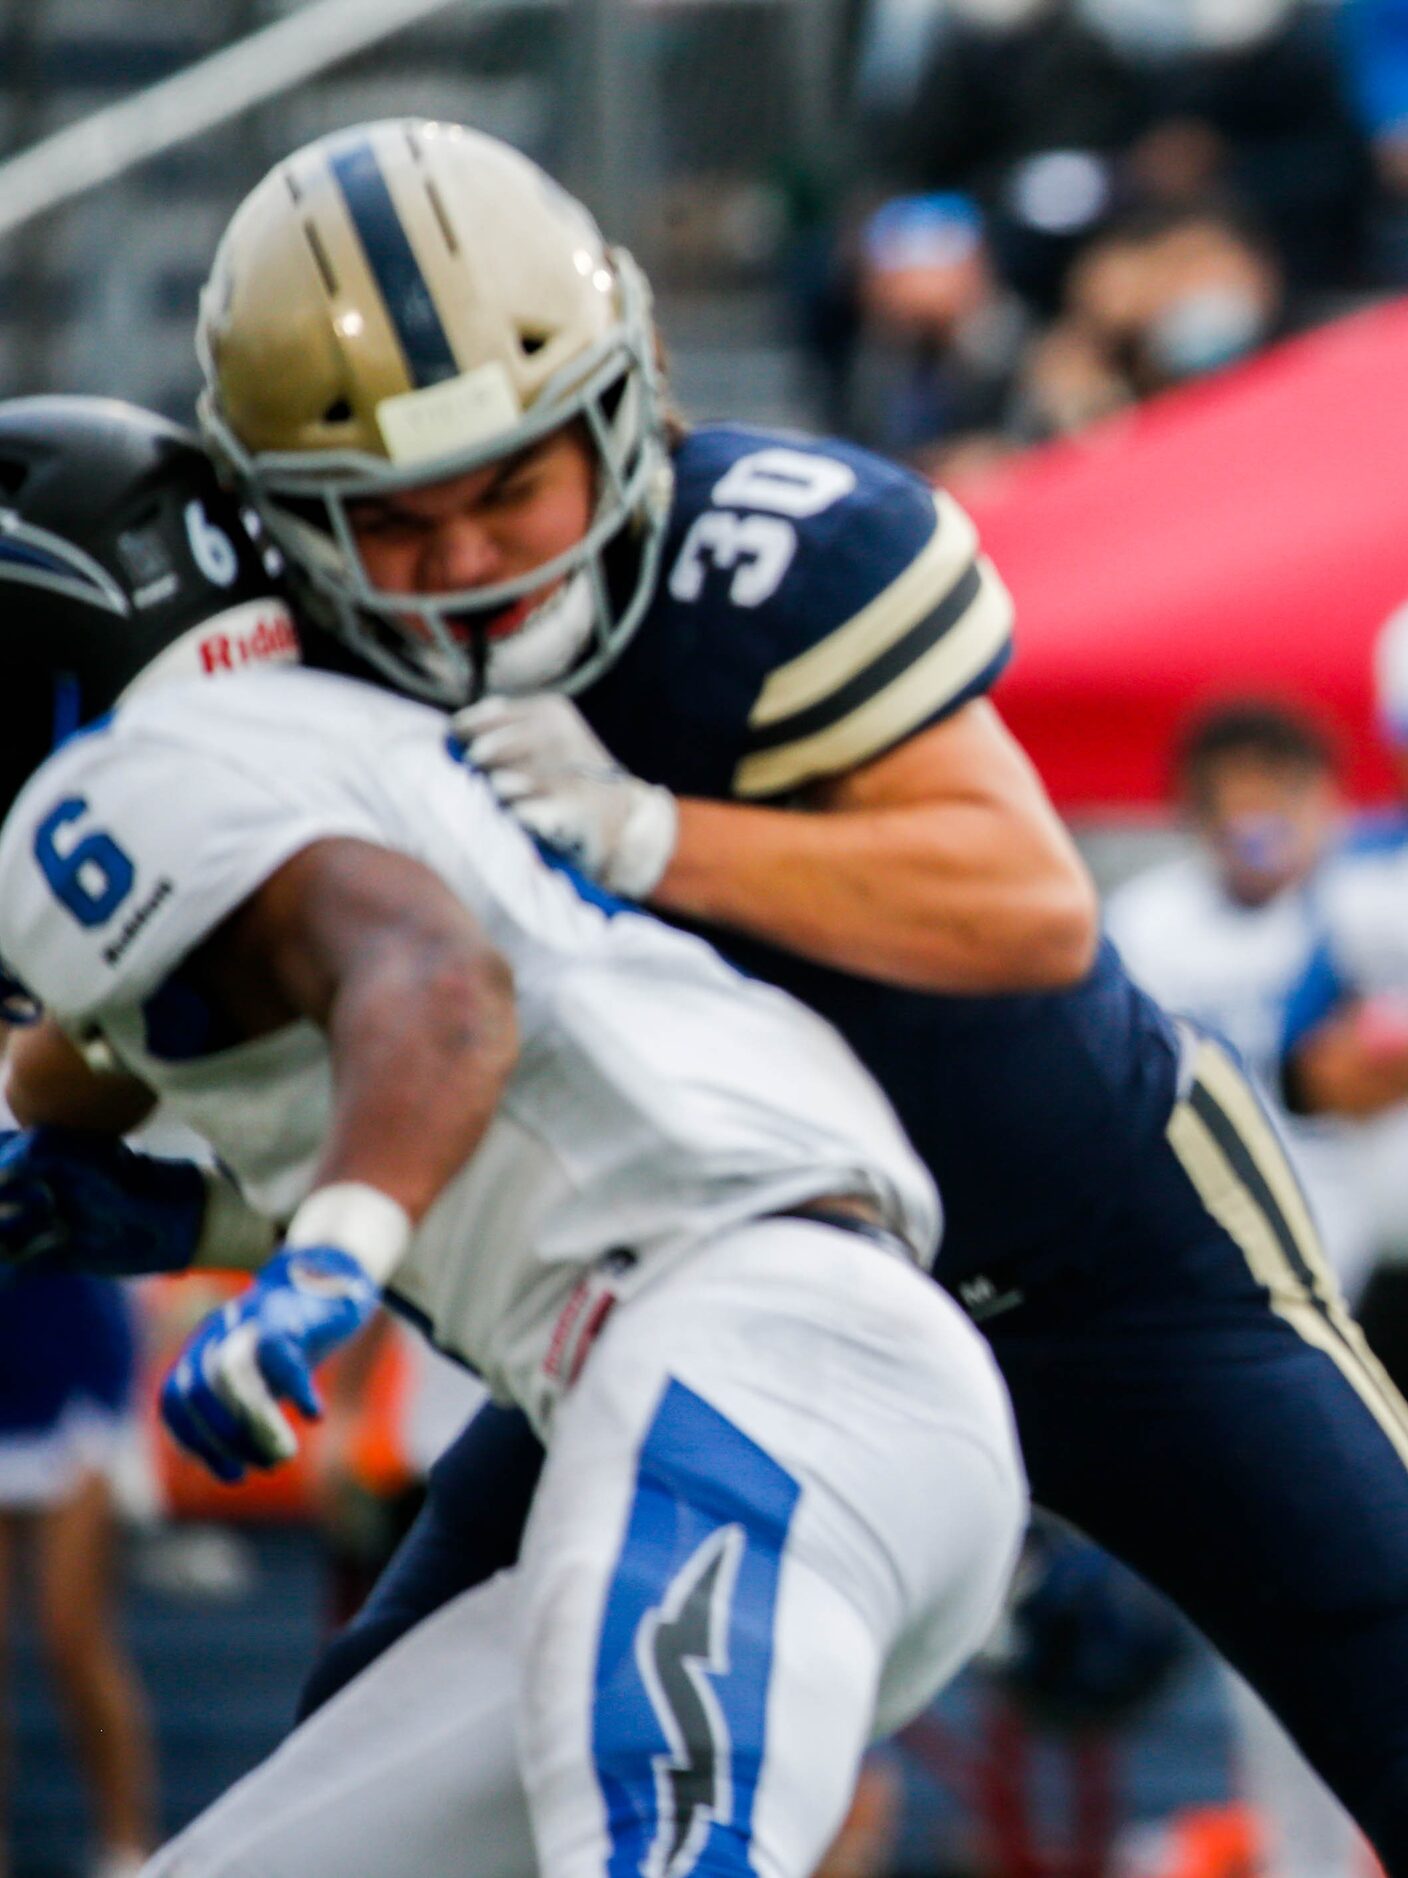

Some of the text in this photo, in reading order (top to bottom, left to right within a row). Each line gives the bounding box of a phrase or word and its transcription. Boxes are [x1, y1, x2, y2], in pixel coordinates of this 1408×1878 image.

[184, 500, 238, 587] 6
[668, 447, 857, 608] 30
[33, 797, 134, 927] 6
